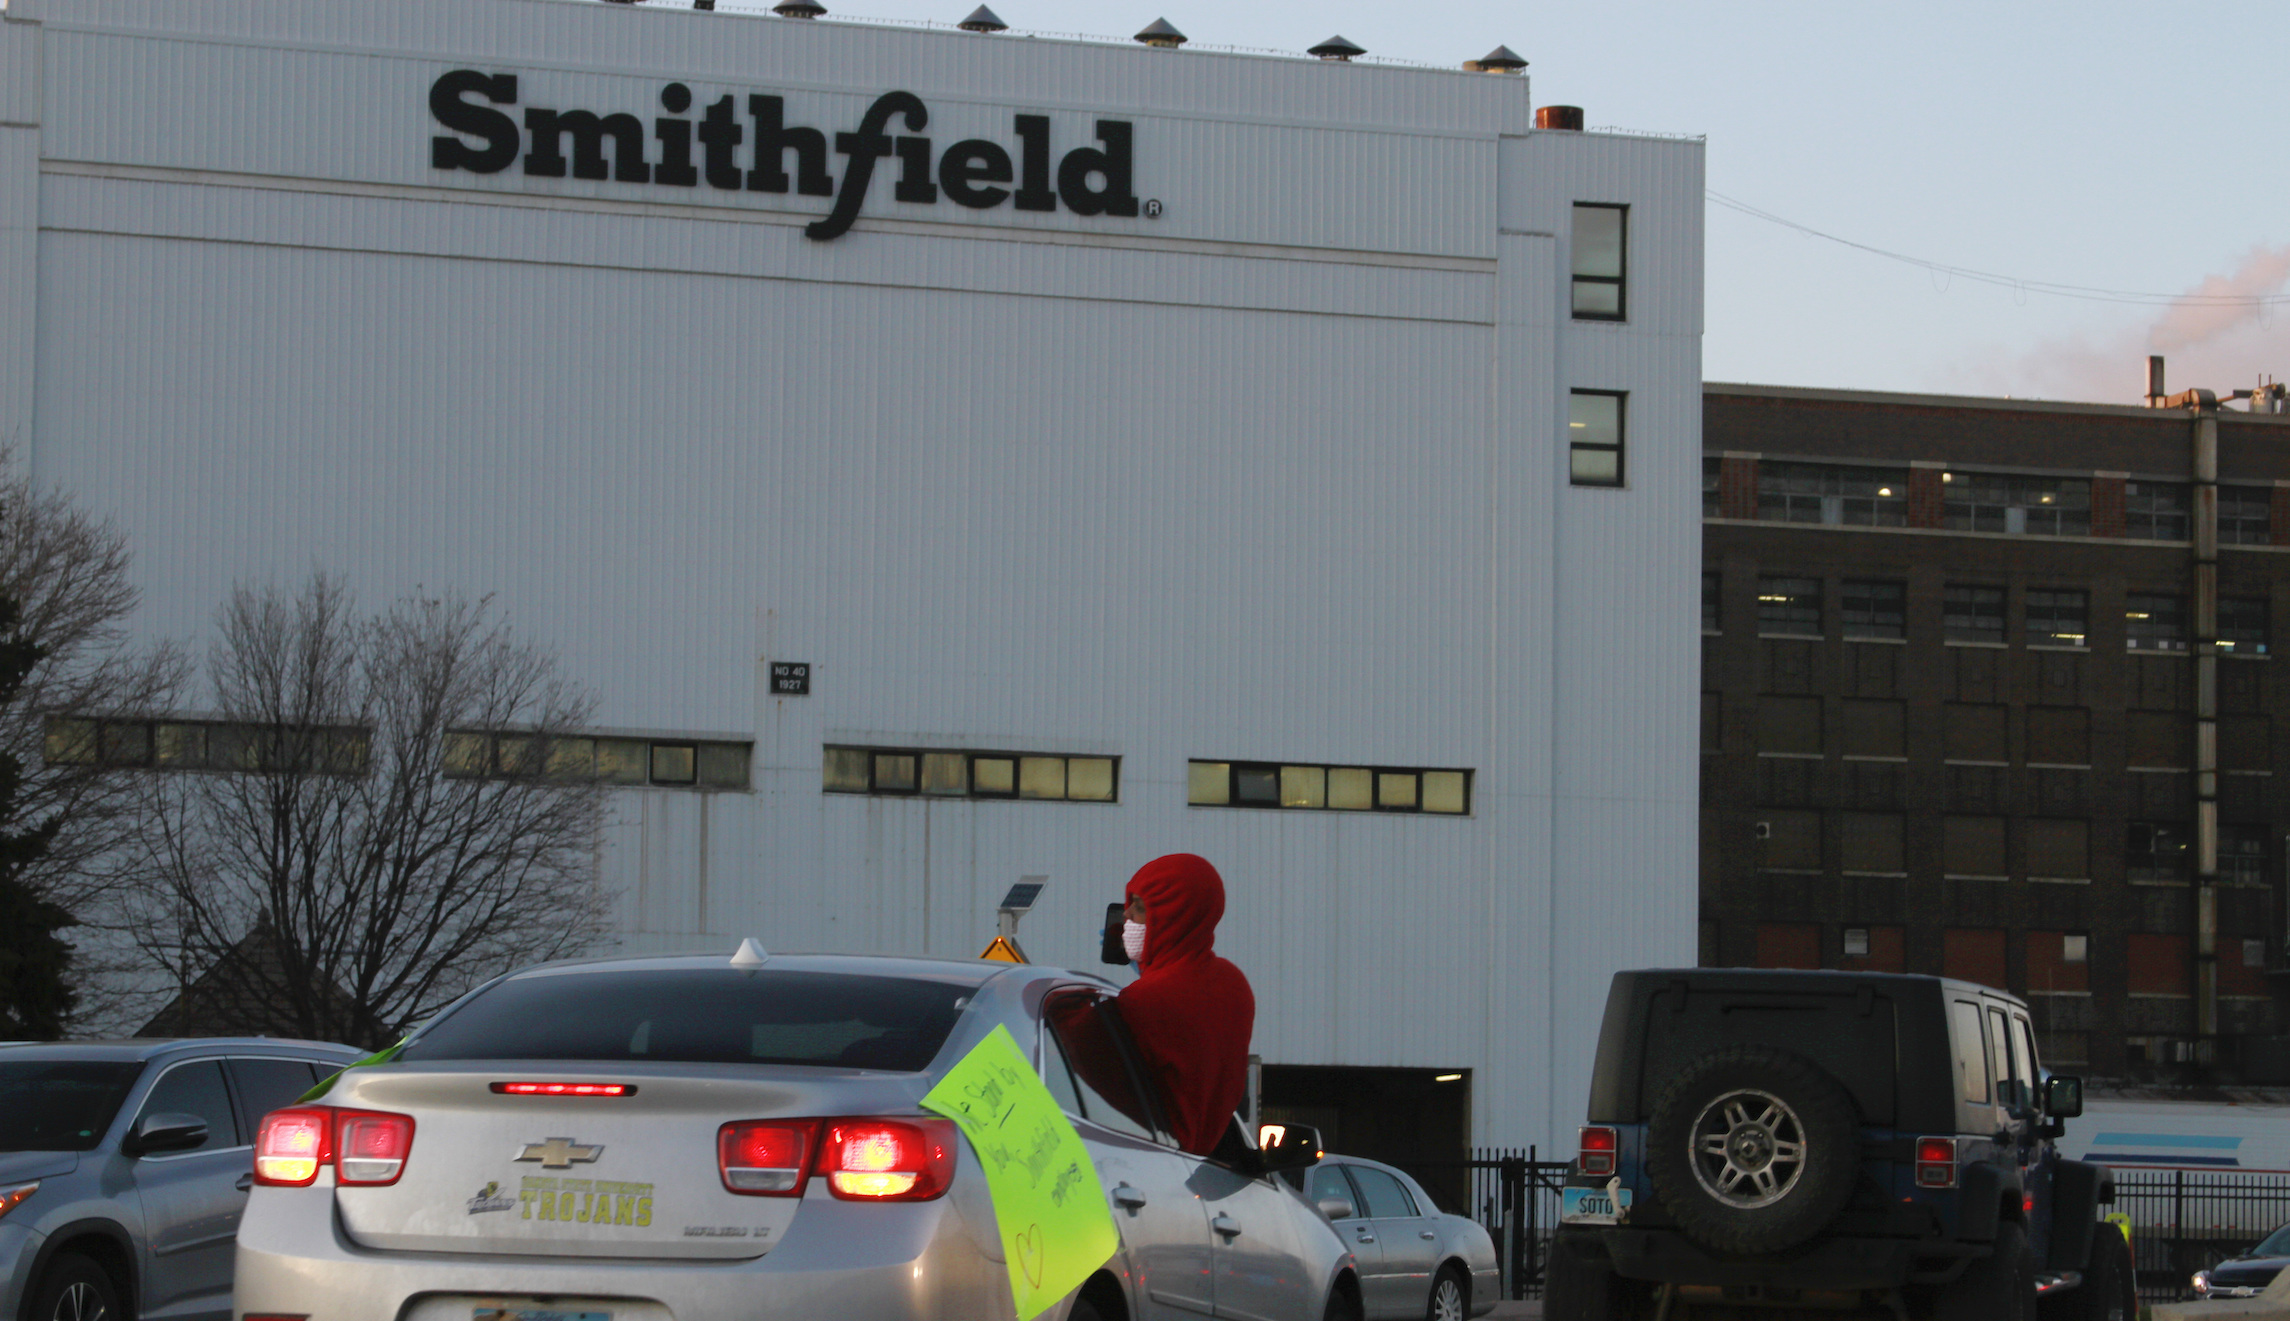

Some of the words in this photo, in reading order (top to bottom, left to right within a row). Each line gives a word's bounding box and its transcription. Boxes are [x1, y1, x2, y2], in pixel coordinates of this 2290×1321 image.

[429, 69, 1139, 241] Smithfield
[792, 666, 806, 677] 40
[779, 680, 801, 690] 1927
[519, 1189, 653, 1227] TROJANS
